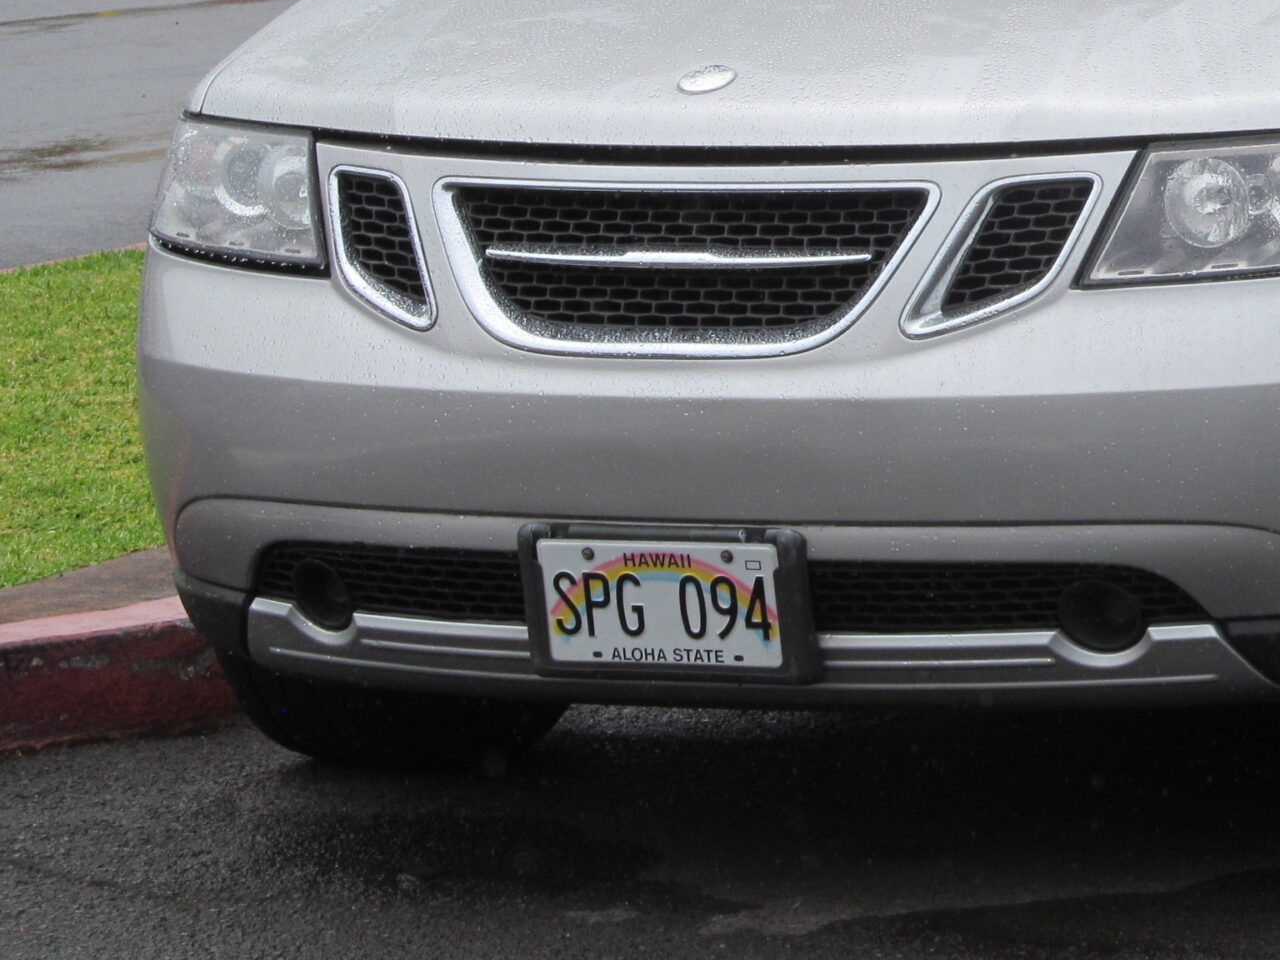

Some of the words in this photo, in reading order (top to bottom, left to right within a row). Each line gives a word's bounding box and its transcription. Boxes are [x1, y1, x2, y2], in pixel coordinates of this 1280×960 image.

[622, 552, 692, 569] HAWAII
[552, 571, 646, 638] SPG
[678, 574, 773, 641] 094
[611, 647, 668, 663] ALOHA
[672, 648, 726, 664] STATE
